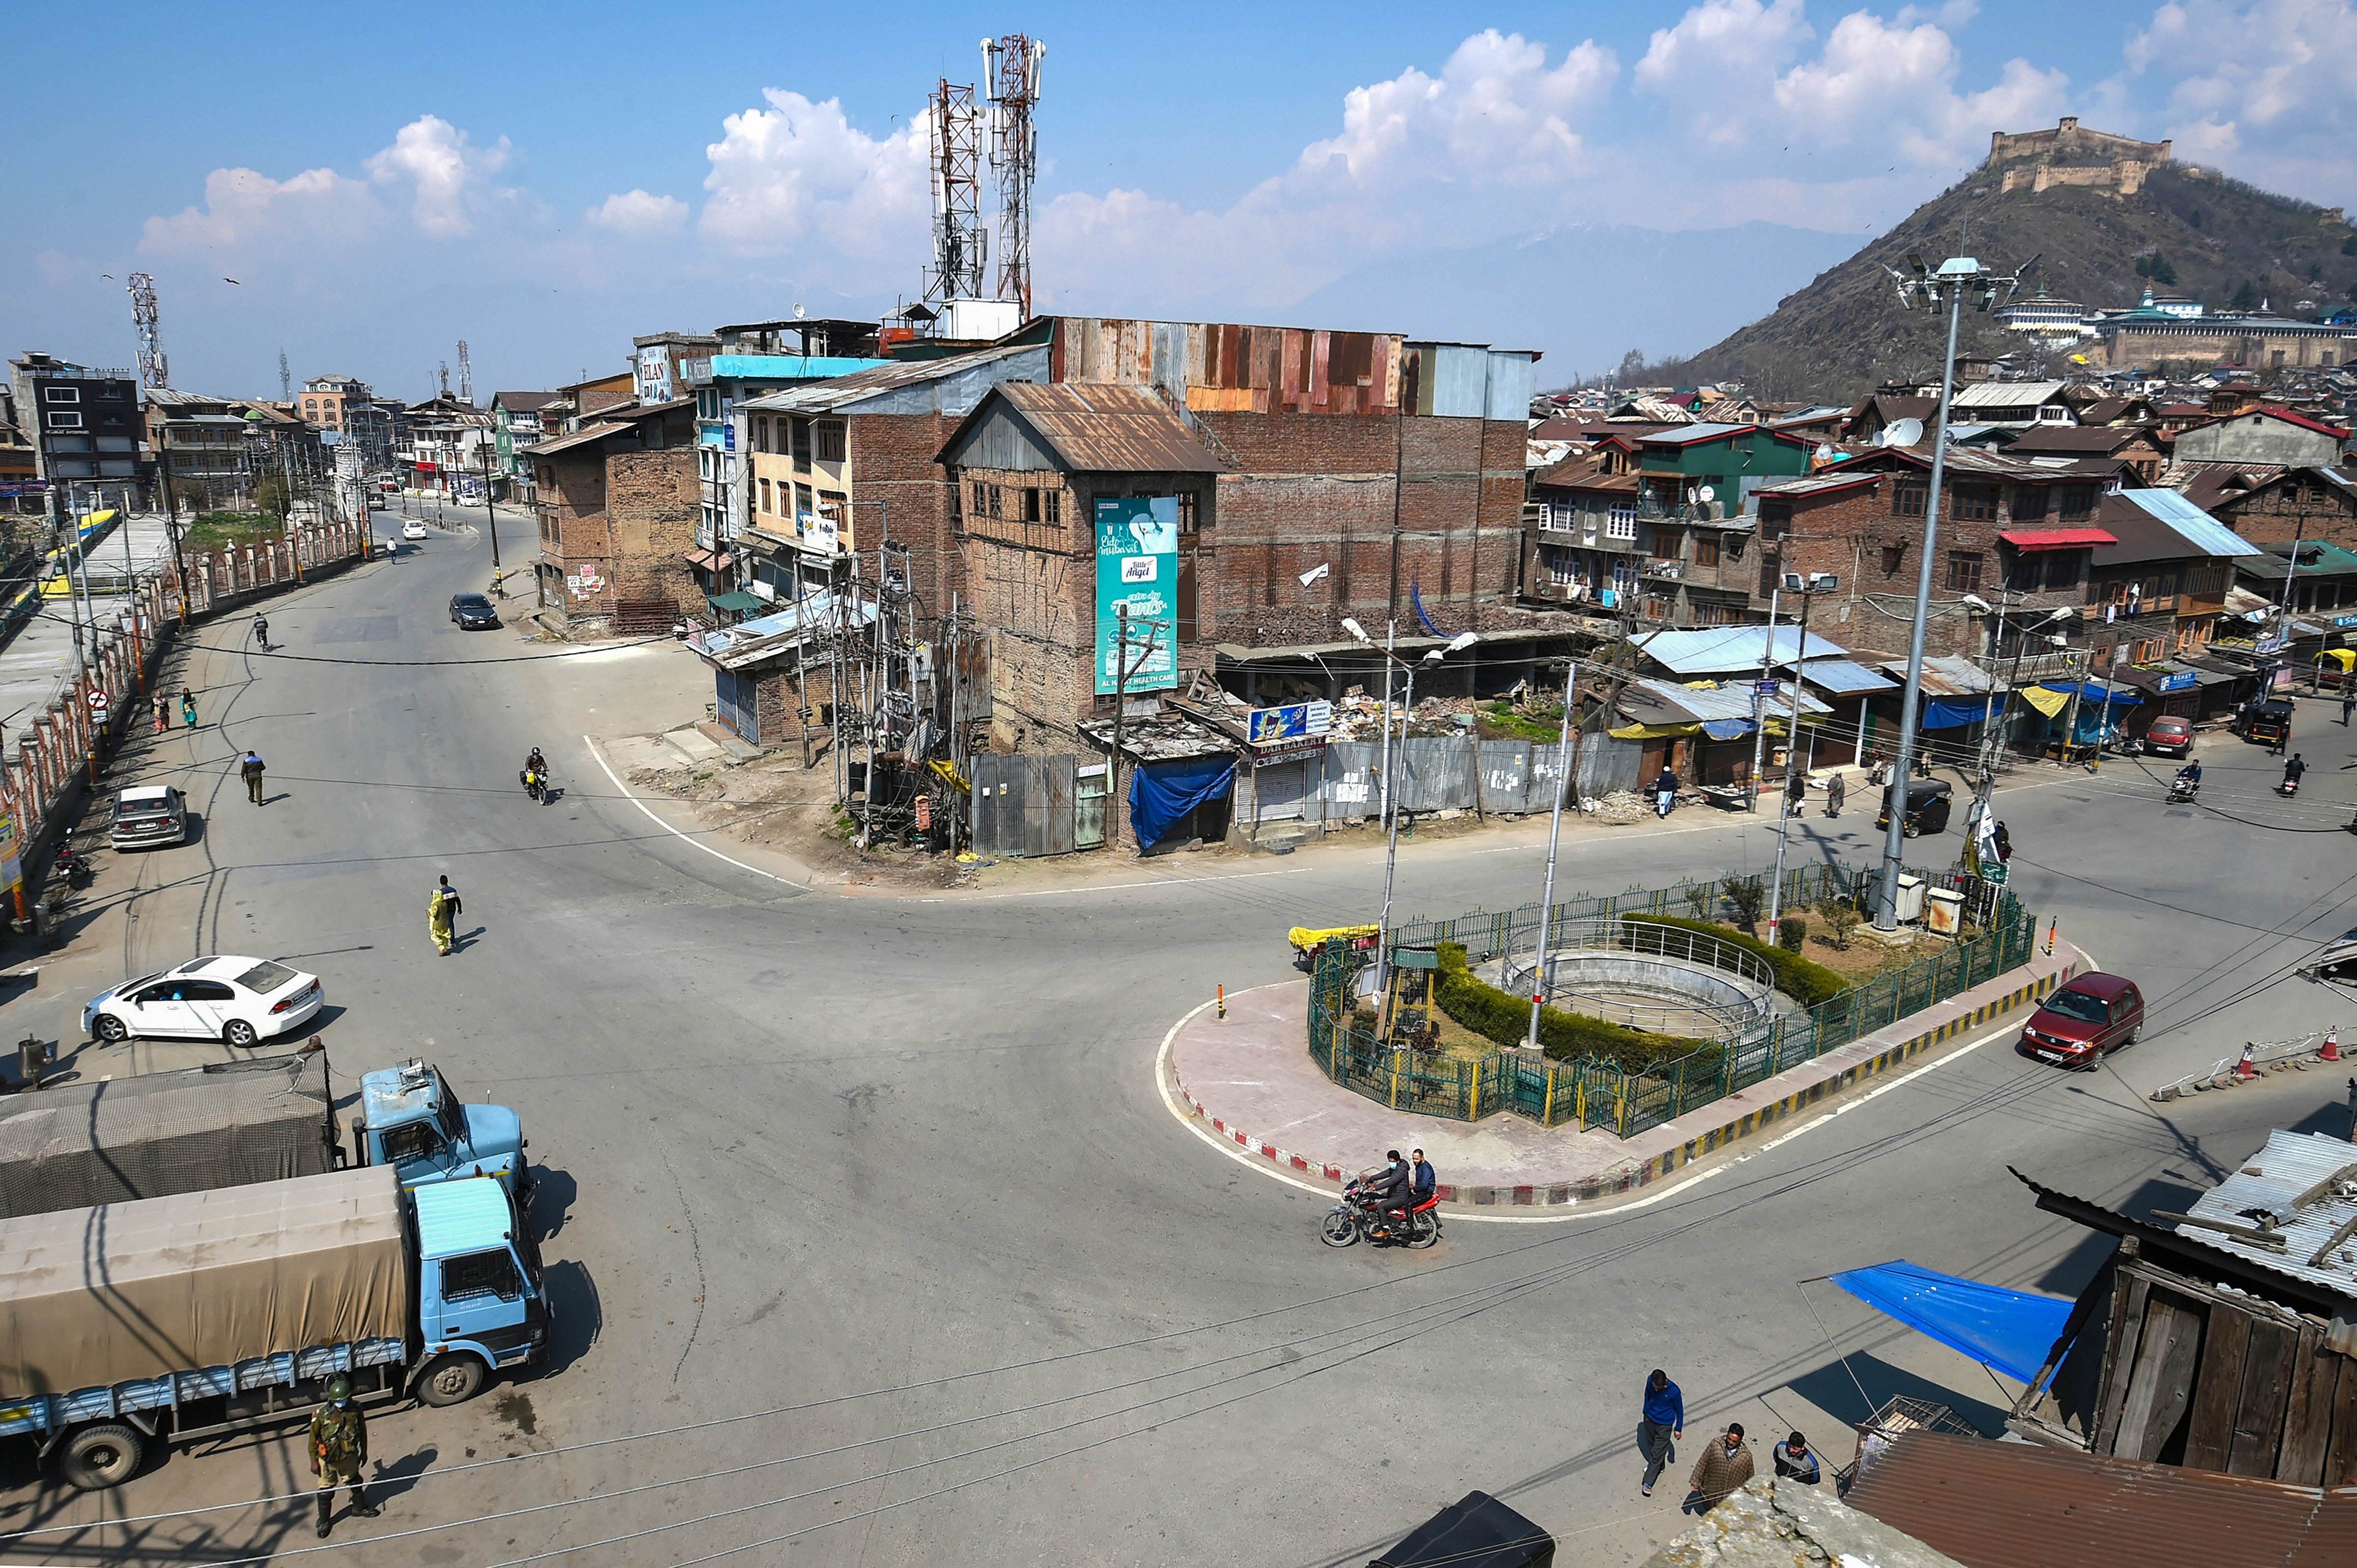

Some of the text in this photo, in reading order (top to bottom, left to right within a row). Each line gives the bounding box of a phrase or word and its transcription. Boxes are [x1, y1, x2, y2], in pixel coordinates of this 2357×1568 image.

[644, 356, 663, 380] ÉLAN
[1101, 535, 1115, 547] Eid
[1132, 562, 1147, 570] Little
[1126, 567, 1150, 579] Angel
[1127, 590, 1161, 601] extra dry
[1261, 736, 1323, 755] DAR BAKERY
